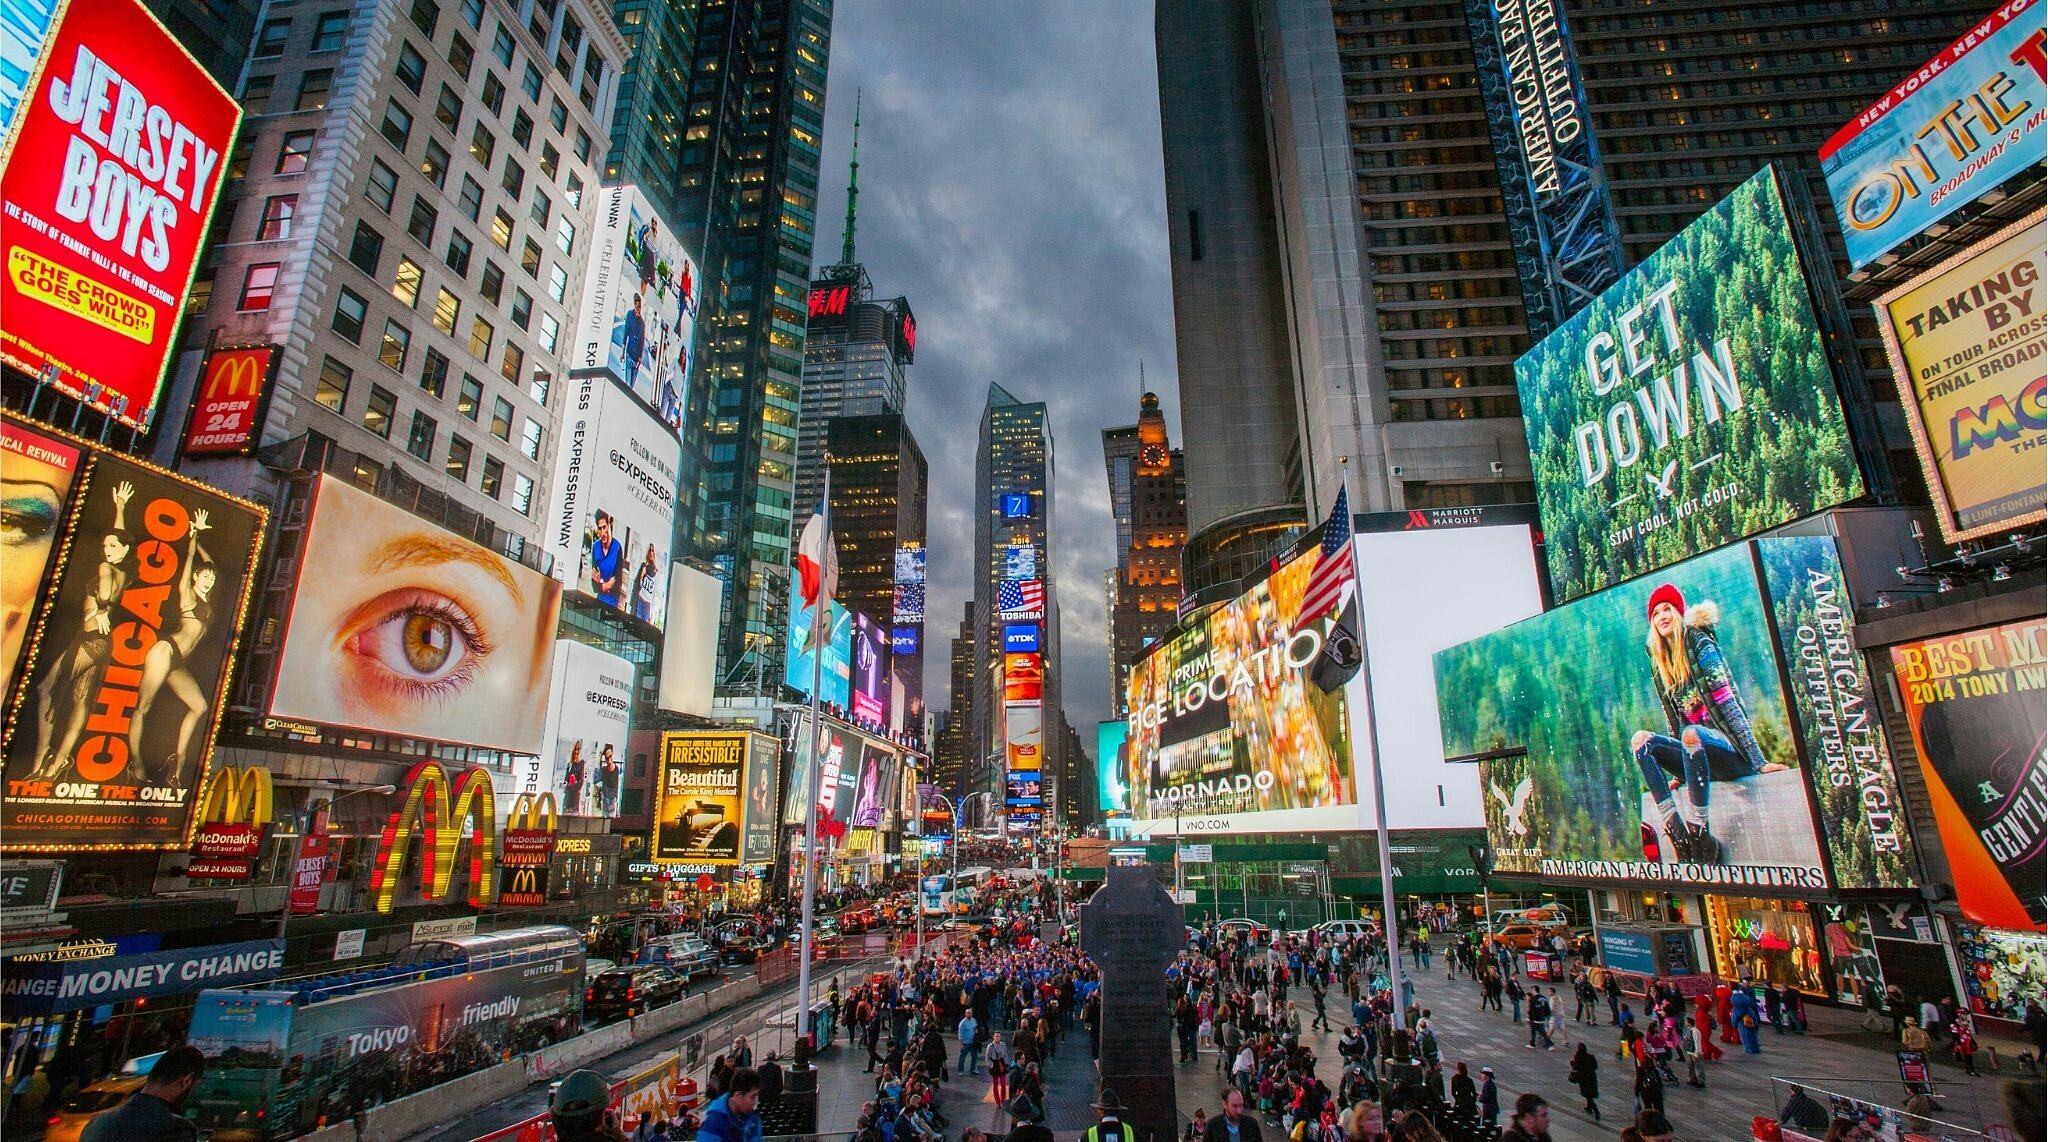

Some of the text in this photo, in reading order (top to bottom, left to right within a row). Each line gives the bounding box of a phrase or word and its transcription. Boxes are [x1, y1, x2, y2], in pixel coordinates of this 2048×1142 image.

[1859, 97, 1891, 127] NEW
[1895, 55, 1948, 97] YORK,
[1953, 21, 1992, 57] NEW
[50, 44, 218, 214] JERSEY
[1507, 44, 1560, 193] AMERICAN
[1847, 71, 2032, 231] ON THE
[1930, 128, 2021, 208] BROADWAY'S
[56, 134, 177, 273] BOYS
[4, 200, 175, 306] THE STORY OF FRANKIE VALLI & THE FOUR SEASONS
[19, 270, 81, 305] GOES
[76, 279, 148, 319] CROWD
[592, 239, 614, 335] #CELEBRATEYOU
[1906, 259, 2039, 338] TAKING
[1983, 287, 2034, 332] BY
[18, 338, 45, 360] Wilson
[1584, 280, 1683, 396] GET
[1921, 361, 1942, 380] ON
[1943, 343, 1985, 370] TOUR
[1926, 371, 1977, 402] FINAL
[205, 413, 241, 431] 24
[206, 401, 250, 412] OPEN
[1575, 338, 1744, 488] DOWN
[192, 433, 247, 445] HOURS
[630, 437, 650, 461] FOLLOW
[2010, 434, 2048, 454] THE
[26, 445, 67, 468] REVIVAL
[559, 420, 587, 549] @EXPRESSRUNWAY
[1432, 508, 1483, 517] MARRIOTT
[1433, 516, 1478, 525] MARQUIS
[1610, 483, 1745, 548] STAY COOL. NOT COLD.
[1000, 612, 1041, 620] TOSHIBA
[75, 499, 190, 780] CHICAGO
[1014, 634, 1035, 642] TDK
[1174, 647, 1220, 685] PRIME
[1901, 634, 1997, 683] BEST
[1911, 679, 1956, 705] 2014
[1957, 671, 2009, 699] TONY
[1128, 699, 1168, 736] FICE
[1797, 625, 1851, 788] OUTFITTERS
[1807, 567, 1901, 853] AMERICAN EAGLE
[8, 781, 188, 802] THE ONE THE ONLY
[668, 768, 739, 787] Beautiful
[699, 788, 714, 796] King
[714, 788, 737, 796] Musical
[1155, 770, 1274, 802] VORNADO
[16, 814, 168, 825] CHICAGOTHEMUSICAL.COM
[1186, 819, 1230, 830] VNO.COM
[197, 832, 258, 845] McDonald's
[505, 836, 552, 844] McDonald's
[556, 840, 591, 852] XPRESS
[1496, 848, 1519, 857] GREAT
[296, 855, 326, 873] JERSEY
[299, 871, 320, 886] BOYS
[629, 864, 716, 874] GIFTS LUGGAGE
[1543, 860, 1825, 889] AMERICAN EAGLE OUTFITTERS
[12, 945, 117, 962] MONEY EXCHANGE
[57, 962, 175, 998] MONEY
[181, 950, 285, 982] CHANGE
[523, 964, 554, 977] UNITED
[348, 1024, 408, 1057] Tokyo
[462, 994, 520, 1026] friendly
